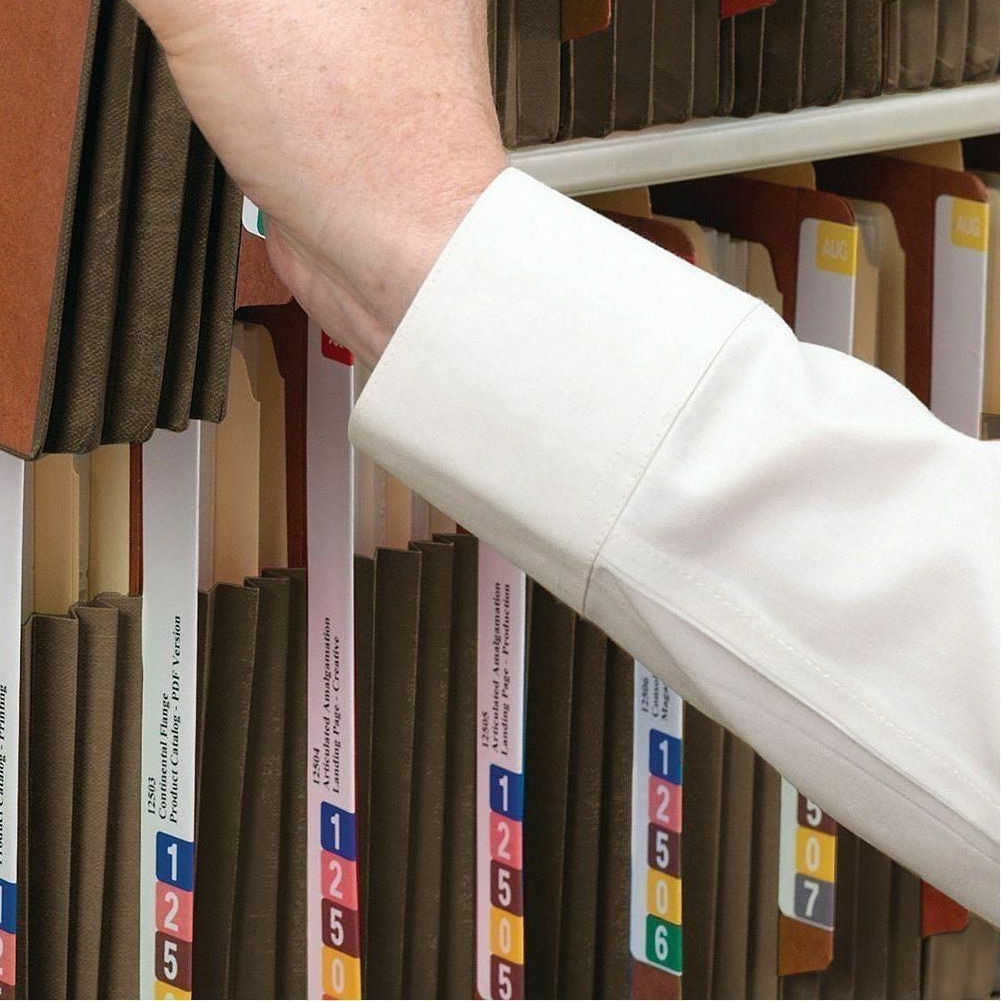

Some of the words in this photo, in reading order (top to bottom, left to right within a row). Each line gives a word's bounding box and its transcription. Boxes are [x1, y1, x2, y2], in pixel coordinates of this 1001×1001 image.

[823, 238, 849, 260] AUG
[956, 214, 981, 237] AUG
[171, 616, 181, 666] Version
[492, 583, 501, 677] Amalgamation
[501, 584, 510, 655] Production
[171, 670, 180, 701] PDF
[323, 617, 331, 713] Amalgamation
[332, 636, 340, 692] Creative
[160, 692, 169, 738] Flange
[170, 714, 180, 766] Catalog
[332, 705, 340, 735] Page
[481, 711, 489, 747] 12505
[501, 703, 509, 756] Landing
[159, 741, 168, 819] Continental
[332, 740, 340, 794] Landing
[147, 777, 156, 814] 12503
[169, 769, 179, 823] Product
